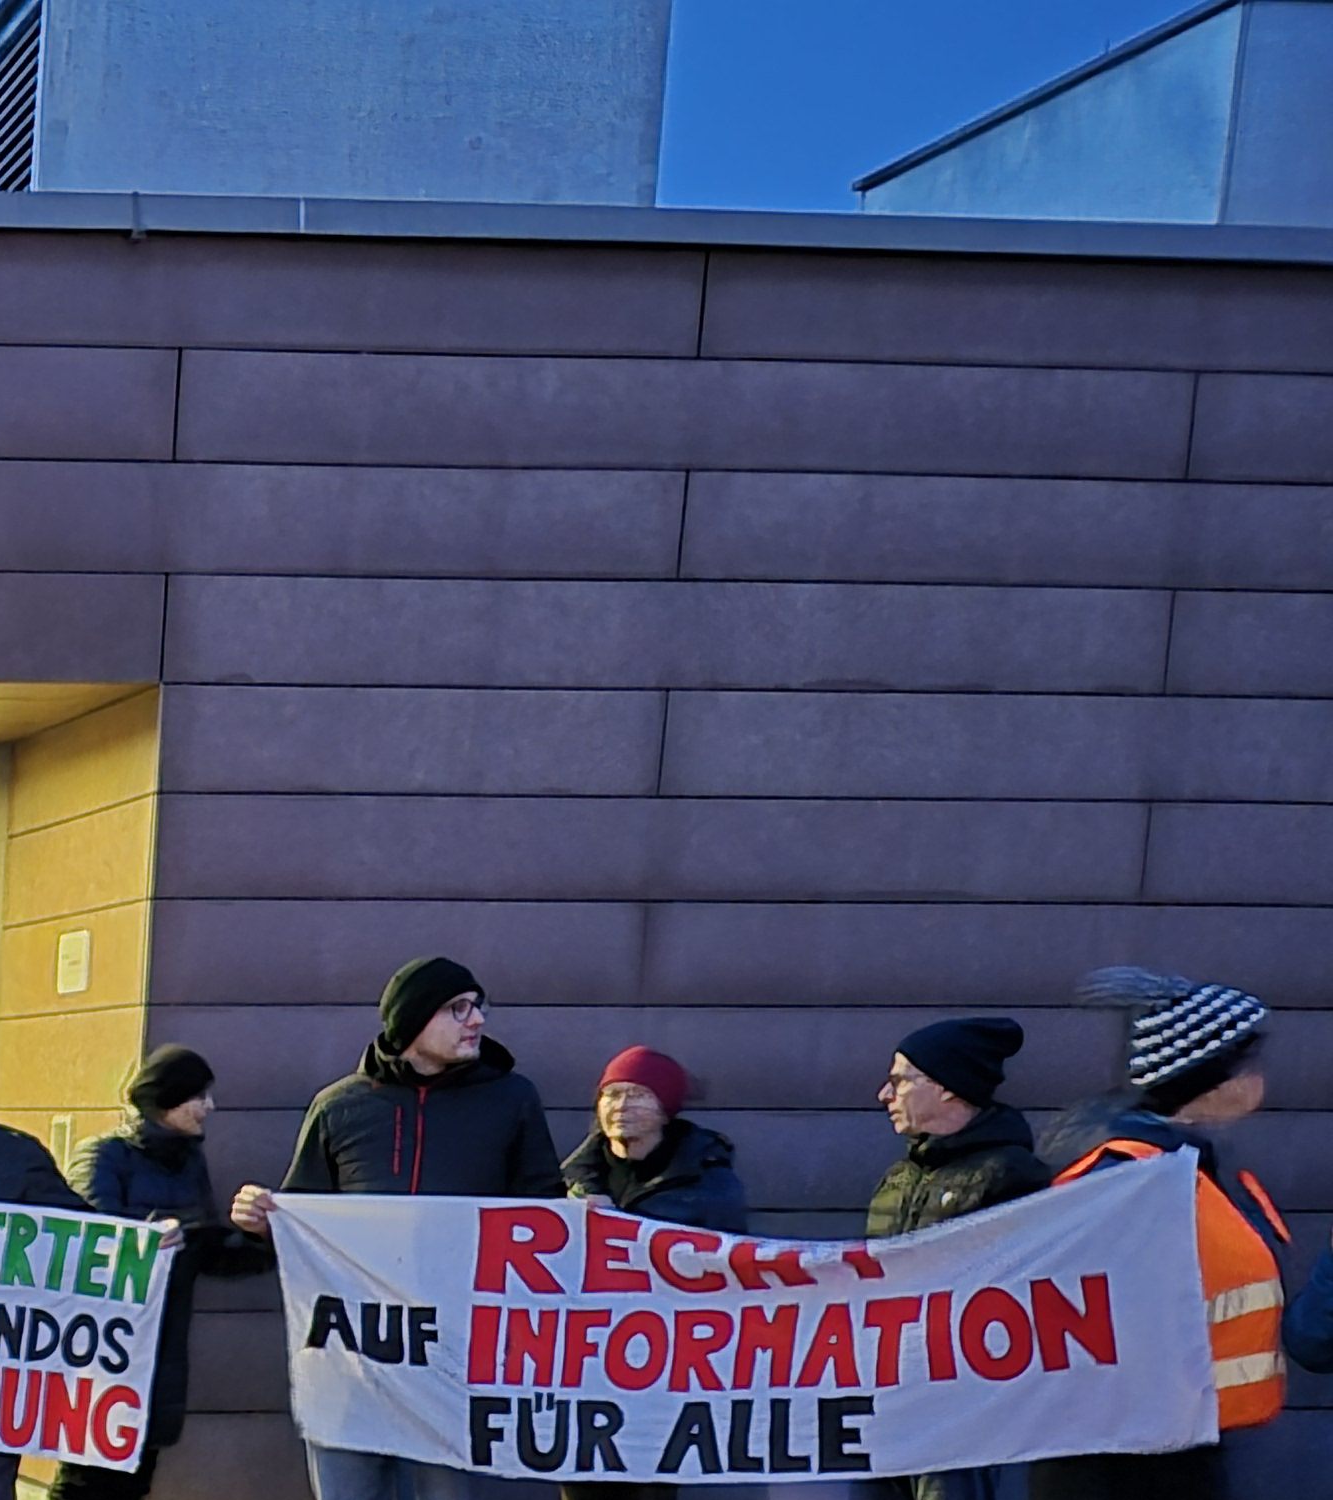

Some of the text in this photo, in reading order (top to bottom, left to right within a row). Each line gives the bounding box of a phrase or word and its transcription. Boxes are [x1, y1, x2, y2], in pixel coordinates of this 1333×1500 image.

[308, 1272, 1118, 1391] AUF INFORMATION
[469, 1393, 875, 1474] FÜR ALLE
